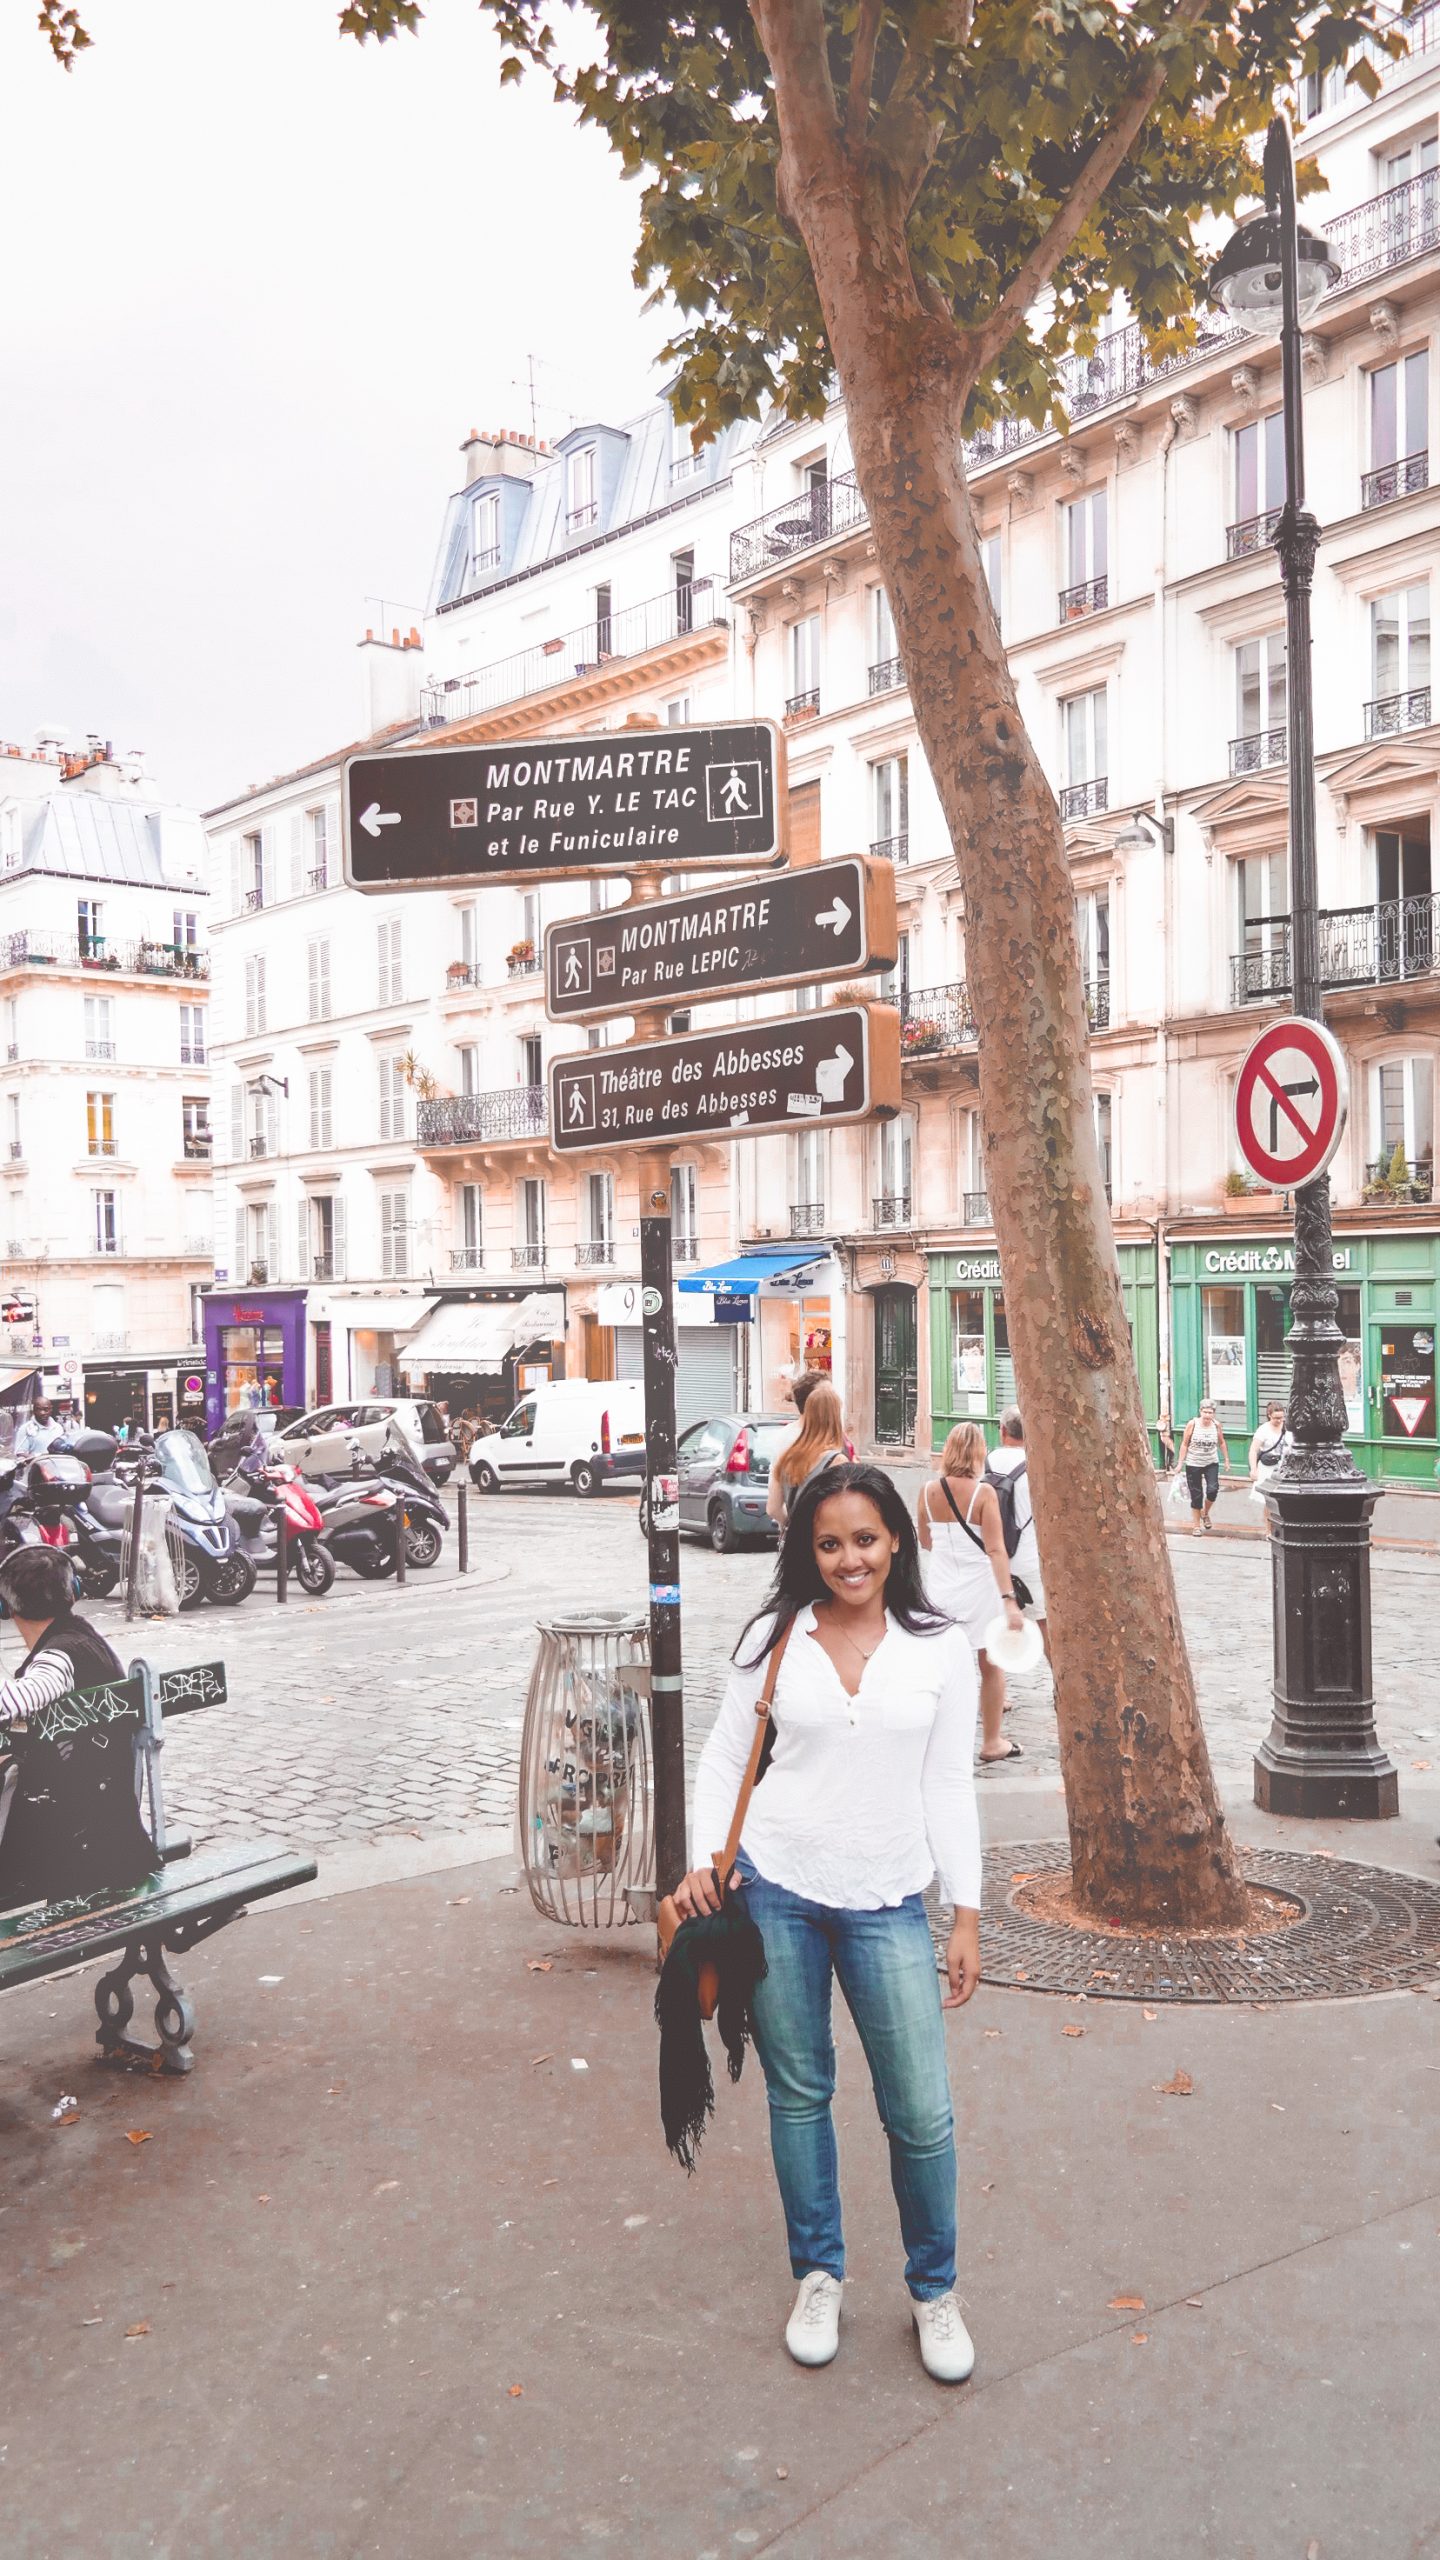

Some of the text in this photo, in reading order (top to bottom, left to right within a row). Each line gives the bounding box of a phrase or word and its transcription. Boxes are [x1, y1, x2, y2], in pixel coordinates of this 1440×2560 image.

[486, 747, 691, 789] MONTMARTRE
[486, 786, 698, 823] Par Rue Y. LE TAC
[487, 824, 679, 857] et le Funiculaire
[621, 898, 771, 953] MONTMARTRE
[621, 946, 740, 987] Par Rue LEPIC
[599, 1045, 804, 1095] Théâtre des Abbesses
[601, 1107, 620, 1131] 31,
[625, 1105, 654, 1125] Rue
[661, 1099, 689, 1121] des
[696, 1088, 777, 1115] Abbesses
[957, 1260, 999, 1279] Crédit
[1205, 1250, 1261, 1272] Crédit
